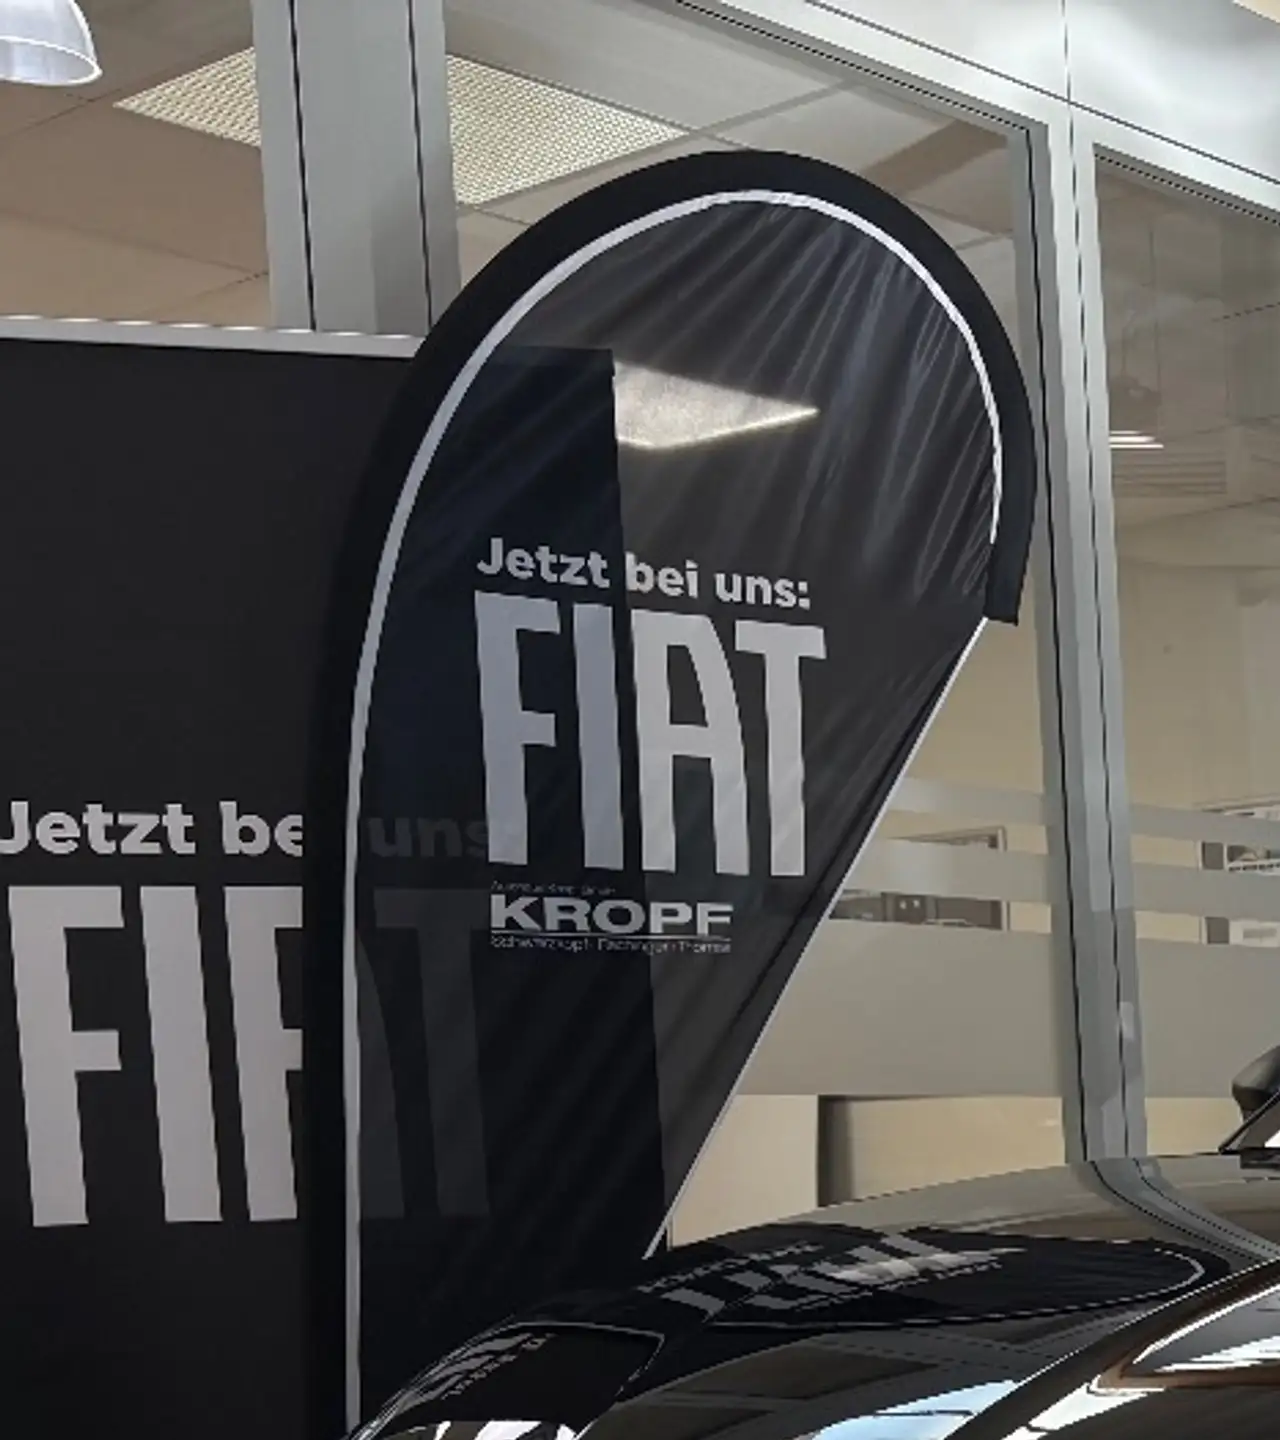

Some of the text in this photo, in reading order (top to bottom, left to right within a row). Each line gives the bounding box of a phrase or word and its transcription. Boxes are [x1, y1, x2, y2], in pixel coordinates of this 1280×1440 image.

[477, 537, 811, 610] Jetzt bei uns:
[474, 589, 827, 877] FIAT
[0, 801, 196, 855] Jetzt
[220, 801, 303, 857] be
[490, 893, 735, 936] KROPF
